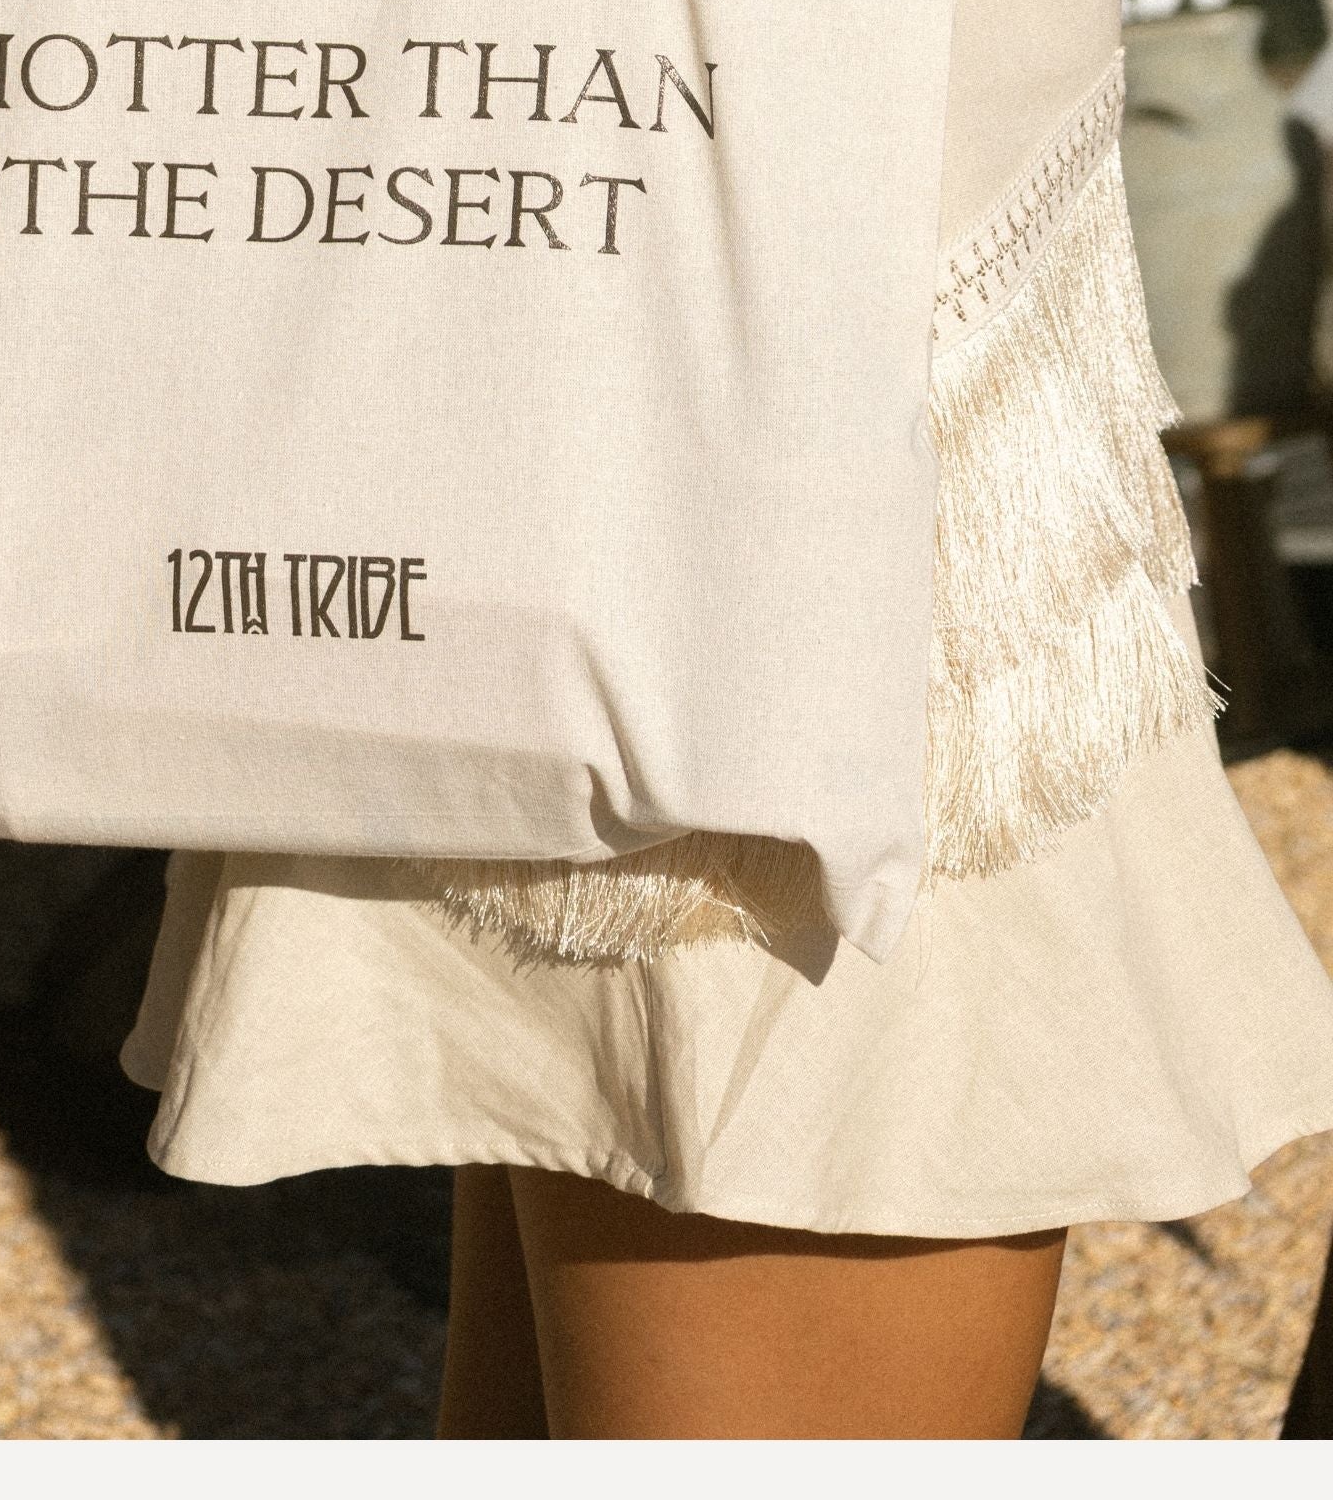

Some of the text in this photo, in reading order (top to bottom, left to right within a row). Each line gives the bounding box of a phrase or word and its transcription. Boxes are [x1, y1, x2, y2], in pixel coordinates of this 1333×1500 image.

[402, 37, 718, 139] THAN
[2, 156, 647, 255] THE DESERT
[167, 548, 427, 641] 12TH TRIBE
